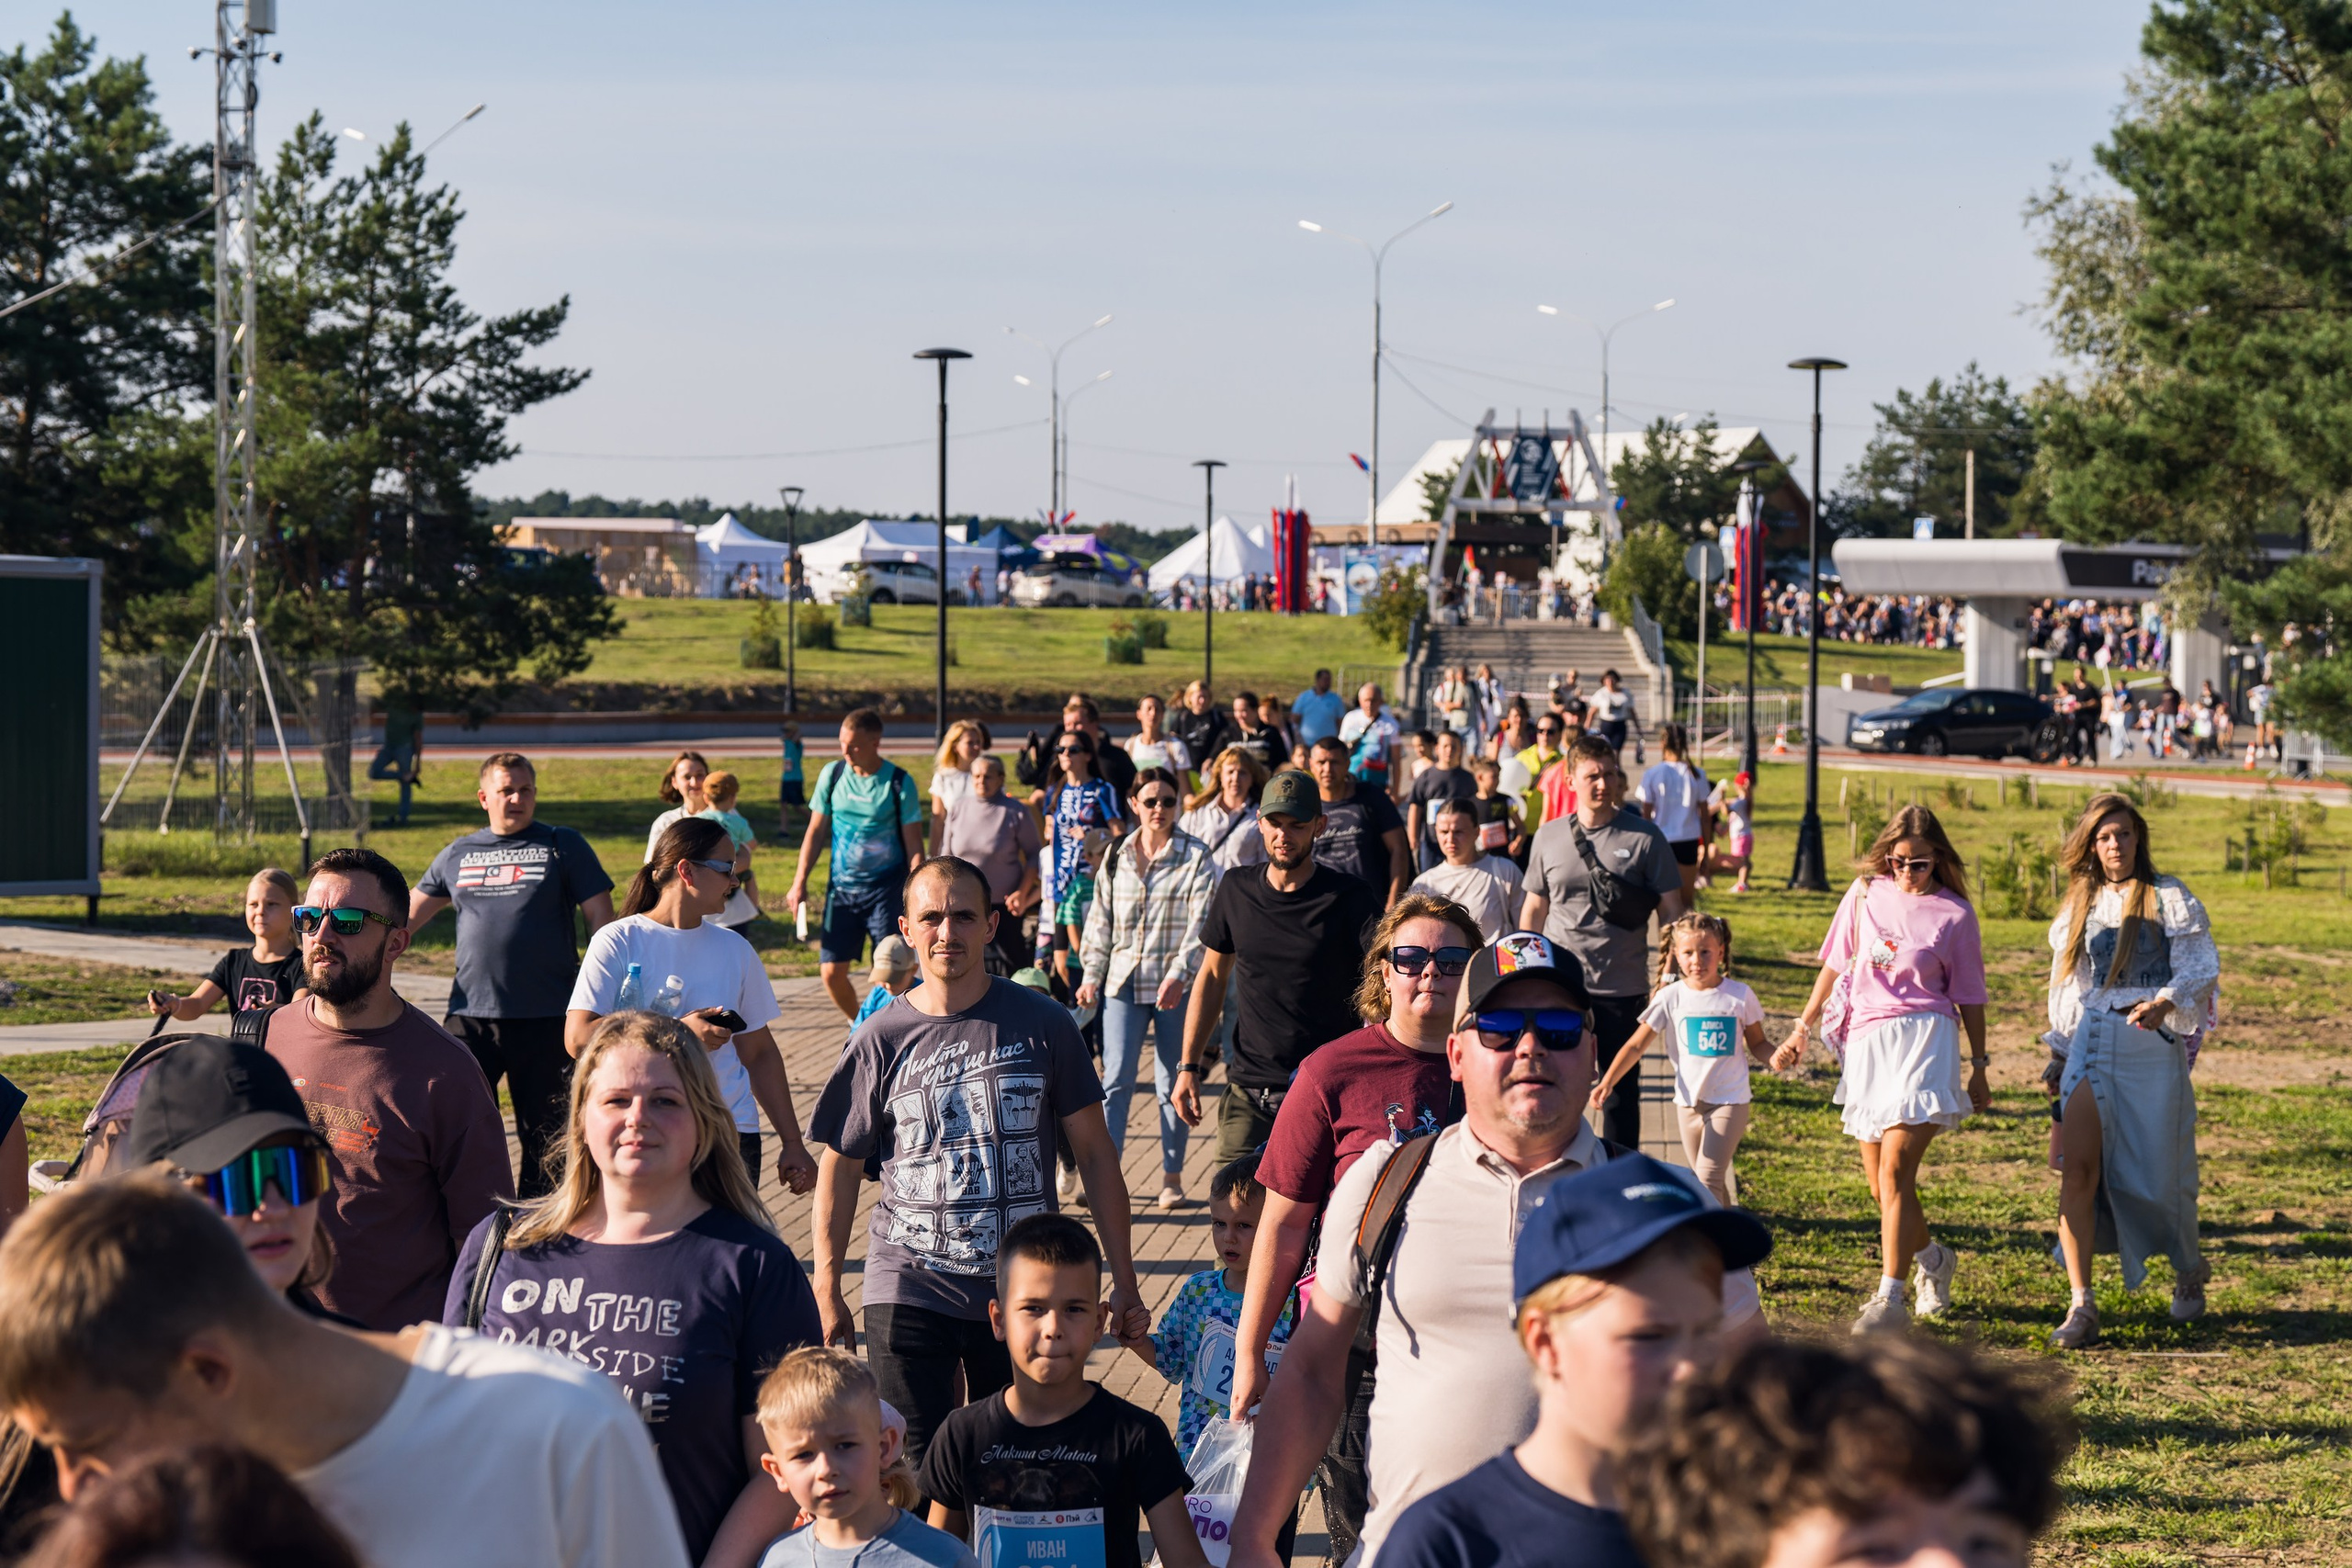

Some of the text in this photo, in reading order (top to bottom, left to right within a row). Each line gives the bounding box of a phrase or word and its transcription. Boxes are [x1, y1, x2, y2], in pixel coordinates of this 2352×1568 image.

[459, 848, 548, 867] ADVENTURE
[1701, 1021, 1724, 1030] АЛИСА
[1698, 1031, 1727, 1051] 542
[987, 1041, 1025, 1064] нас
[502, 1277, 682, 1337] ON THE
[584, 1347, 684, 1384] SIDE
[980, 1444, 1098, 1464] Hakuna Matata
[1066, 1514, 1080, 1523] Пэй
[1026, 1540, 1067, 1559] ИВАН
